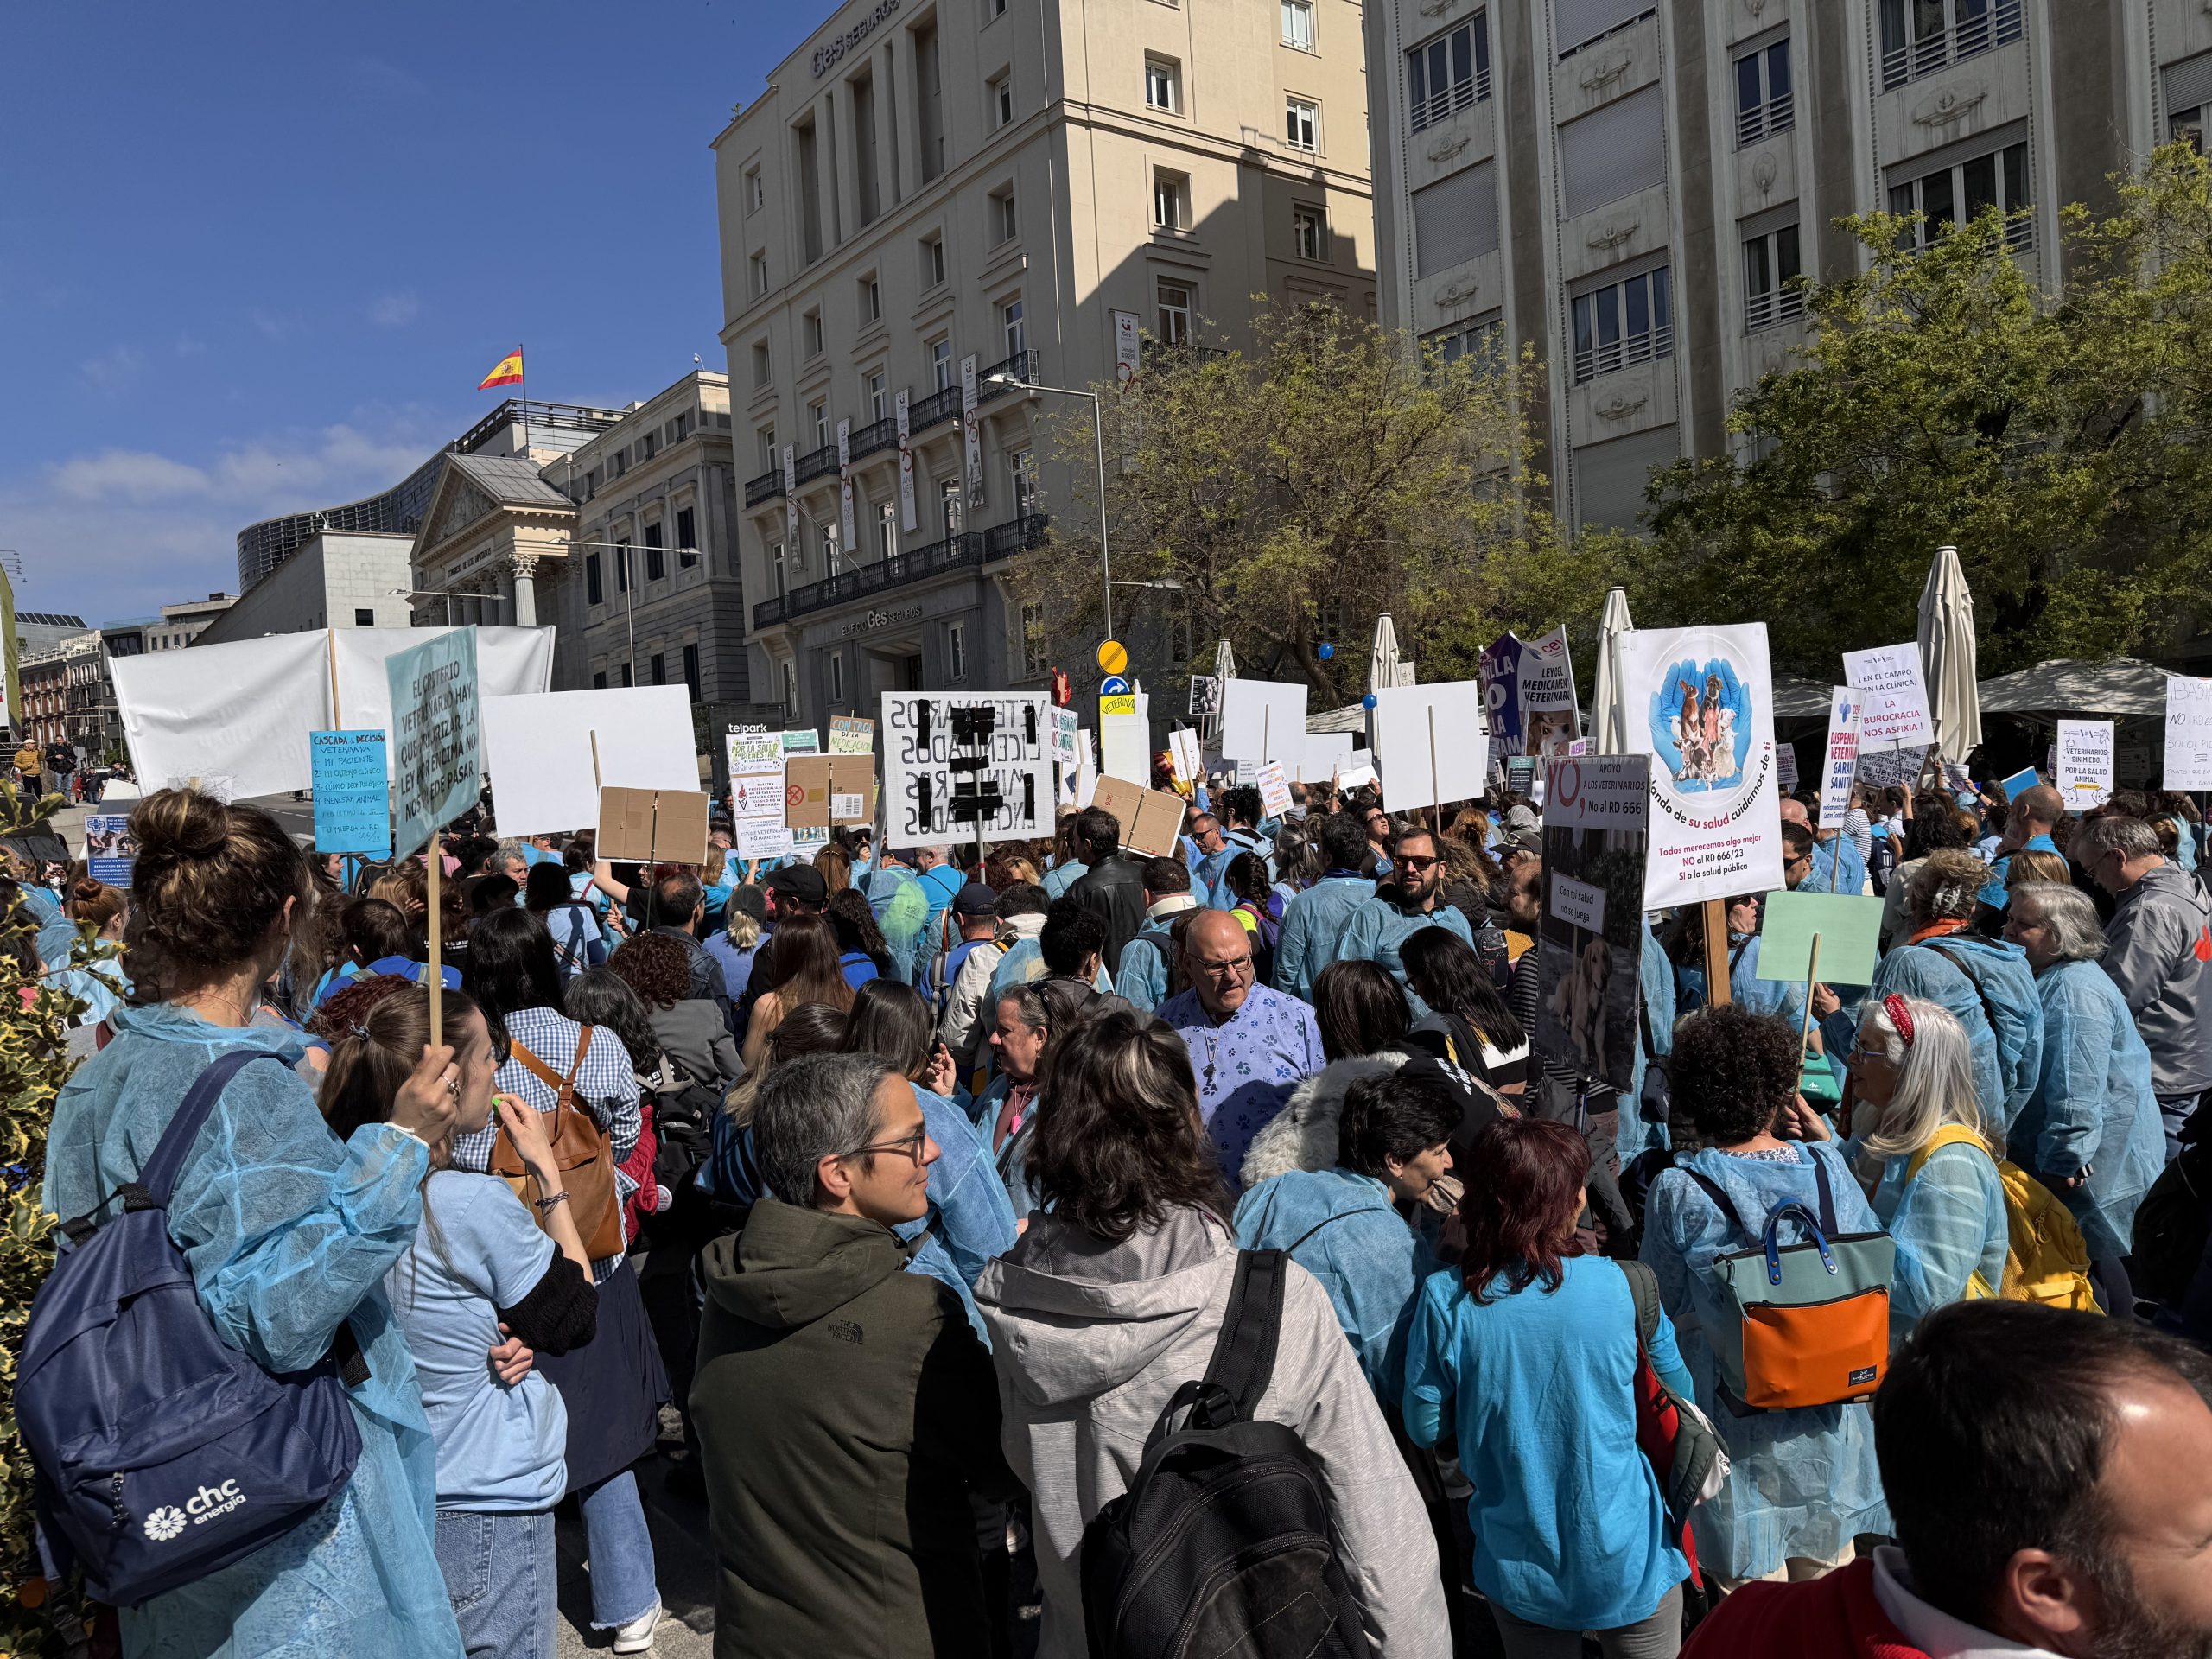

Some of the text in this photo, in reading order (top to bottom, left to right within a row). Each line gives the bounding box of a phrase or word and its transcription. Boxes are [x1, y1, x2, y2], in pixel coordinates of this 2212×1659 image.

[812, 35, 844, 79] Ges
[842, 605, 920, 636] EDIFICIO Ges SEGUROS
[413, 660, 460, 699] EL CRITERIO
[1541, 666, 1564, 678] LEY DEL
[1885, 669, 1912, 679] CAMPO
[401, 681, 473, 734] VETERINARIO HAY
[1864, 710, 1920, 724] BUROCRACIA
[2170, 713, 2186, 725] NO
[728, 723, 767, 734] telpark
[832, 719, 872, 734] CONTROL
[1864, 728, 1883, 738] NOS
[1885, 723, 1918, 734] ASFIXIA
[313, 735, 347, 746] CASCADA
[401, 741, 417, 768] QUE
[466, 709, 475, 728] LA
[830, 736, 871, 752] MEDICACIÓN
[1763, 741, 1771, 751] ti
[741, 751, 777, 760] BIENESTAR
[757, 743, 778, 753] SALUD
[324, 755, 374, 766] MI PACIENTE
[401, 732, 476, 796] LEY POR ENCIMA NO
[1762, 754, 1770, 771] de
[1599, 764, 1621, 774] APOYO
[1584, 780, 1645, 791] A LOS VETERINARIOS
[2075, 775, 2097, 784] ANIMAL
[356, 794, 381, 804] ANIMAL
[405, 760, 474, 823] NOS PUEDE PASAR
[1731, 772, 1766, 821] cuidamos
[1589, 800, 1642, 815] No al RD 666
[1674, 810, 1687, 823] de
[1689, 817, 1700, 829] su
[1703, 812, 1730, 830] salud
[334, 825, 358, 834] MIERDA
[1659, 833, 1762, 856] Todos merecemos algo mejor
[1682, 849, 1744, 867] NO al RD 666/23
[1679, 871, 1686, 880] SI
[1694, 869, 1700, 878] la
[1702, 866, 1722, 878] salud
[1723, 862, 1748, 875] pública
[1560, 885, 1594, 906] Con mi salud
[1560, 905, 1590, 924] no se juega
[828, 1323, 849, 1335] NORTH
[833, 1332, 850, 1341] FACE
[186, 1478, 240, 1514] chc
[194, 1494, 246, 1525] energía
